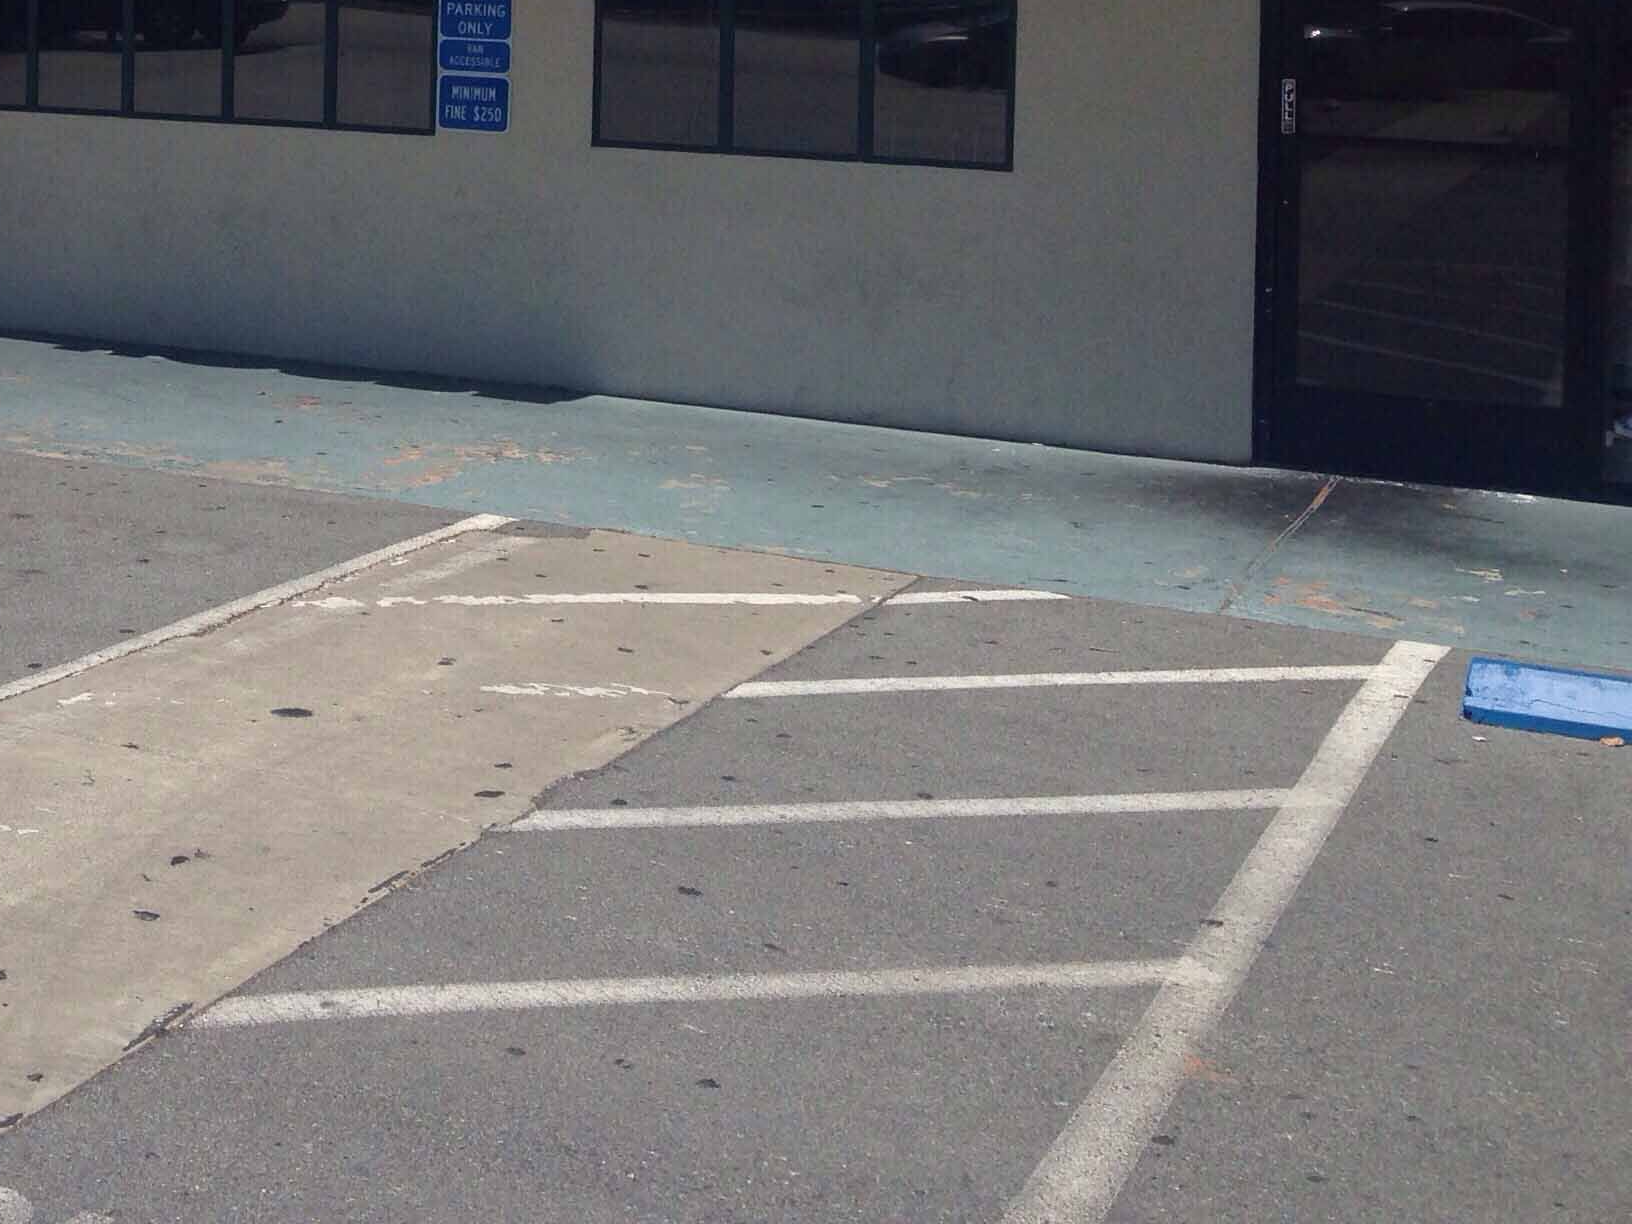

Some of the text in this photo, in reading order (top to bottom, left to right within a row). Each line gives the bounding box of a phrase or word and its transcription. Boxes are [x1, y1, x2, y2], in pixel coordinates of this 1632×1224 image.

[446, 2, 507, 18] PARKING
[458, 21, 494, 36] ONLY
[451, 85, 497, 102] MINIMUM
[1284, 83, 1293, 120] PULL
[444, 104, 503, 123] FINE $250
